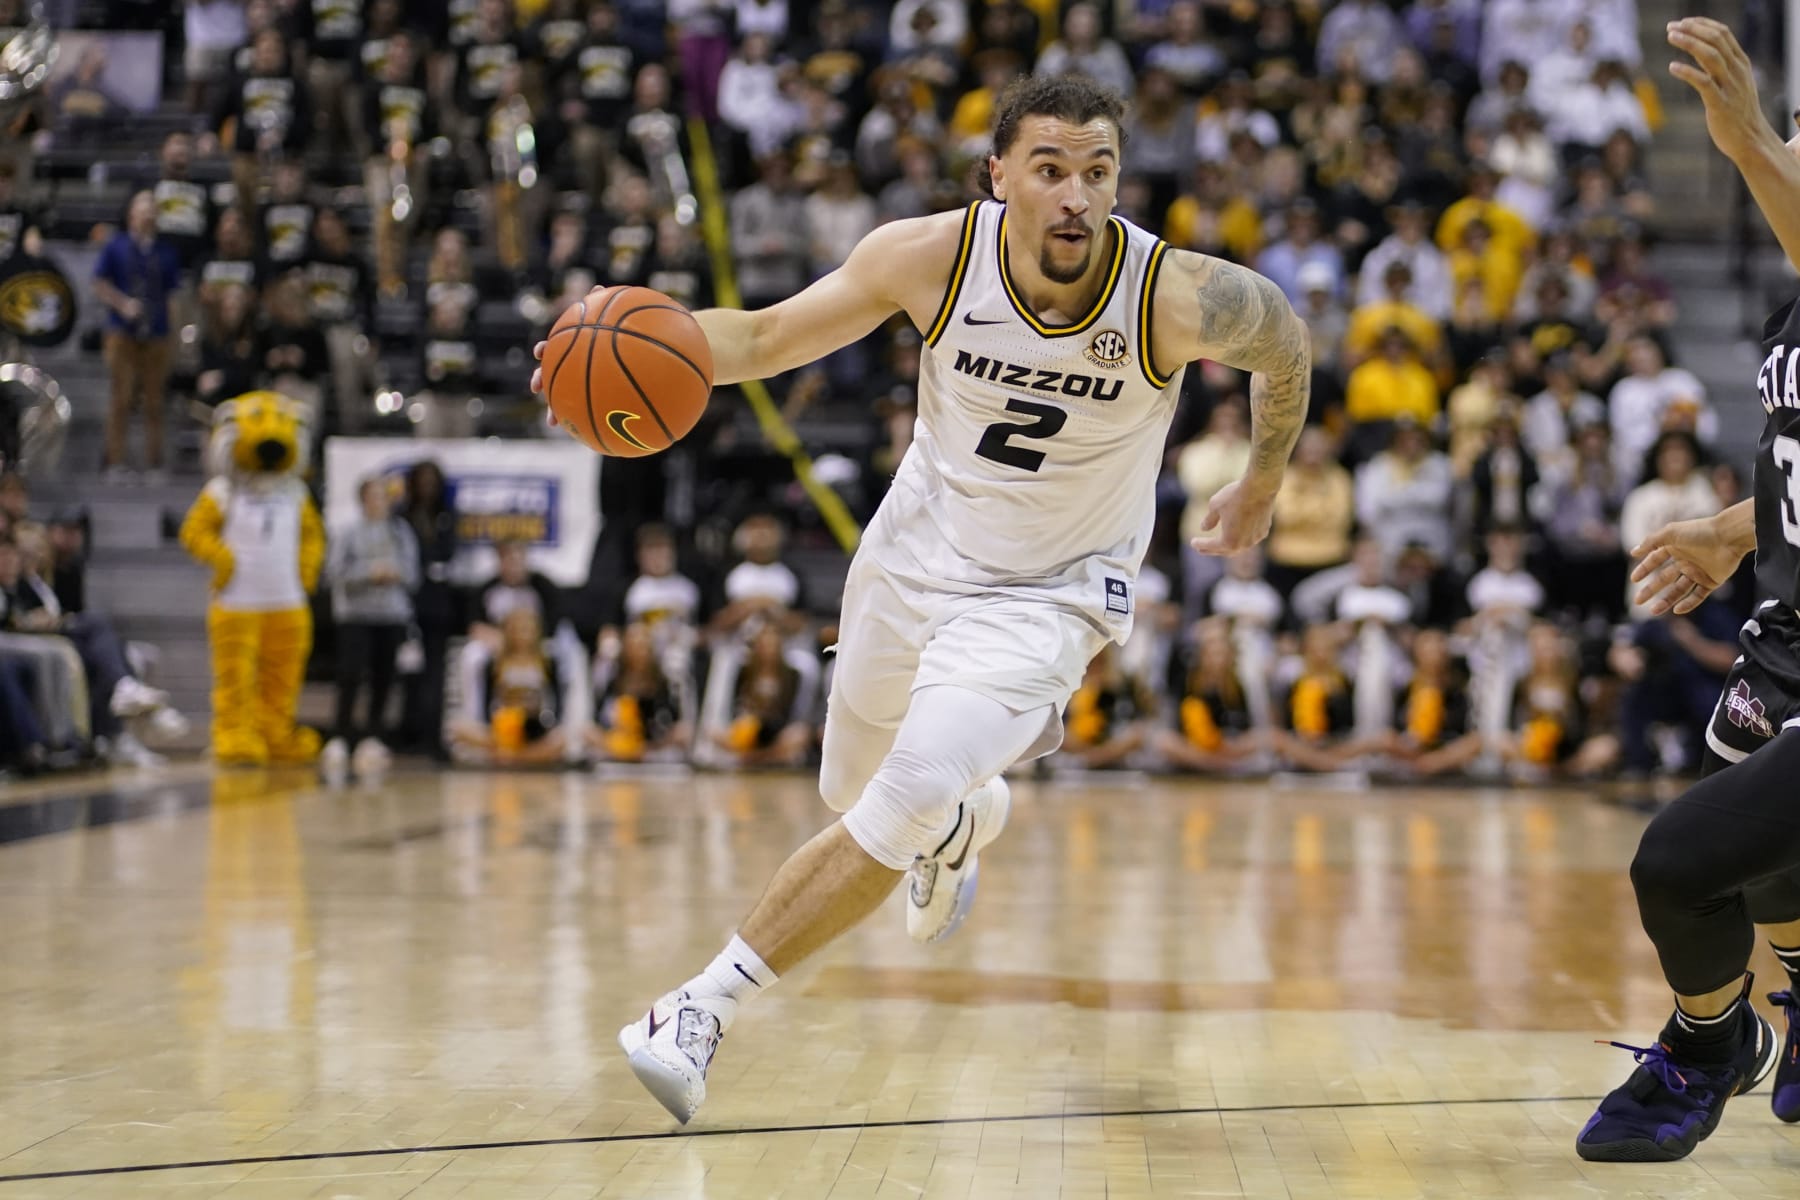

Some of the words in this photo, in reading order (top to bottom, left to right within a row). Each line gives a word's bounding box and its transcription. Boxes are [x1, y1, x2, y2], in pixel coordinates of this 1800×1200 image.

[1093, 331, 1125, 360] SEC
[953, 350, 1125, 401] MIZZOU
[1087, 354, 1126, 369] GRADUATE
[974, 398, 1068, 472] 2
[1111, 582, 1123, 594] 46
